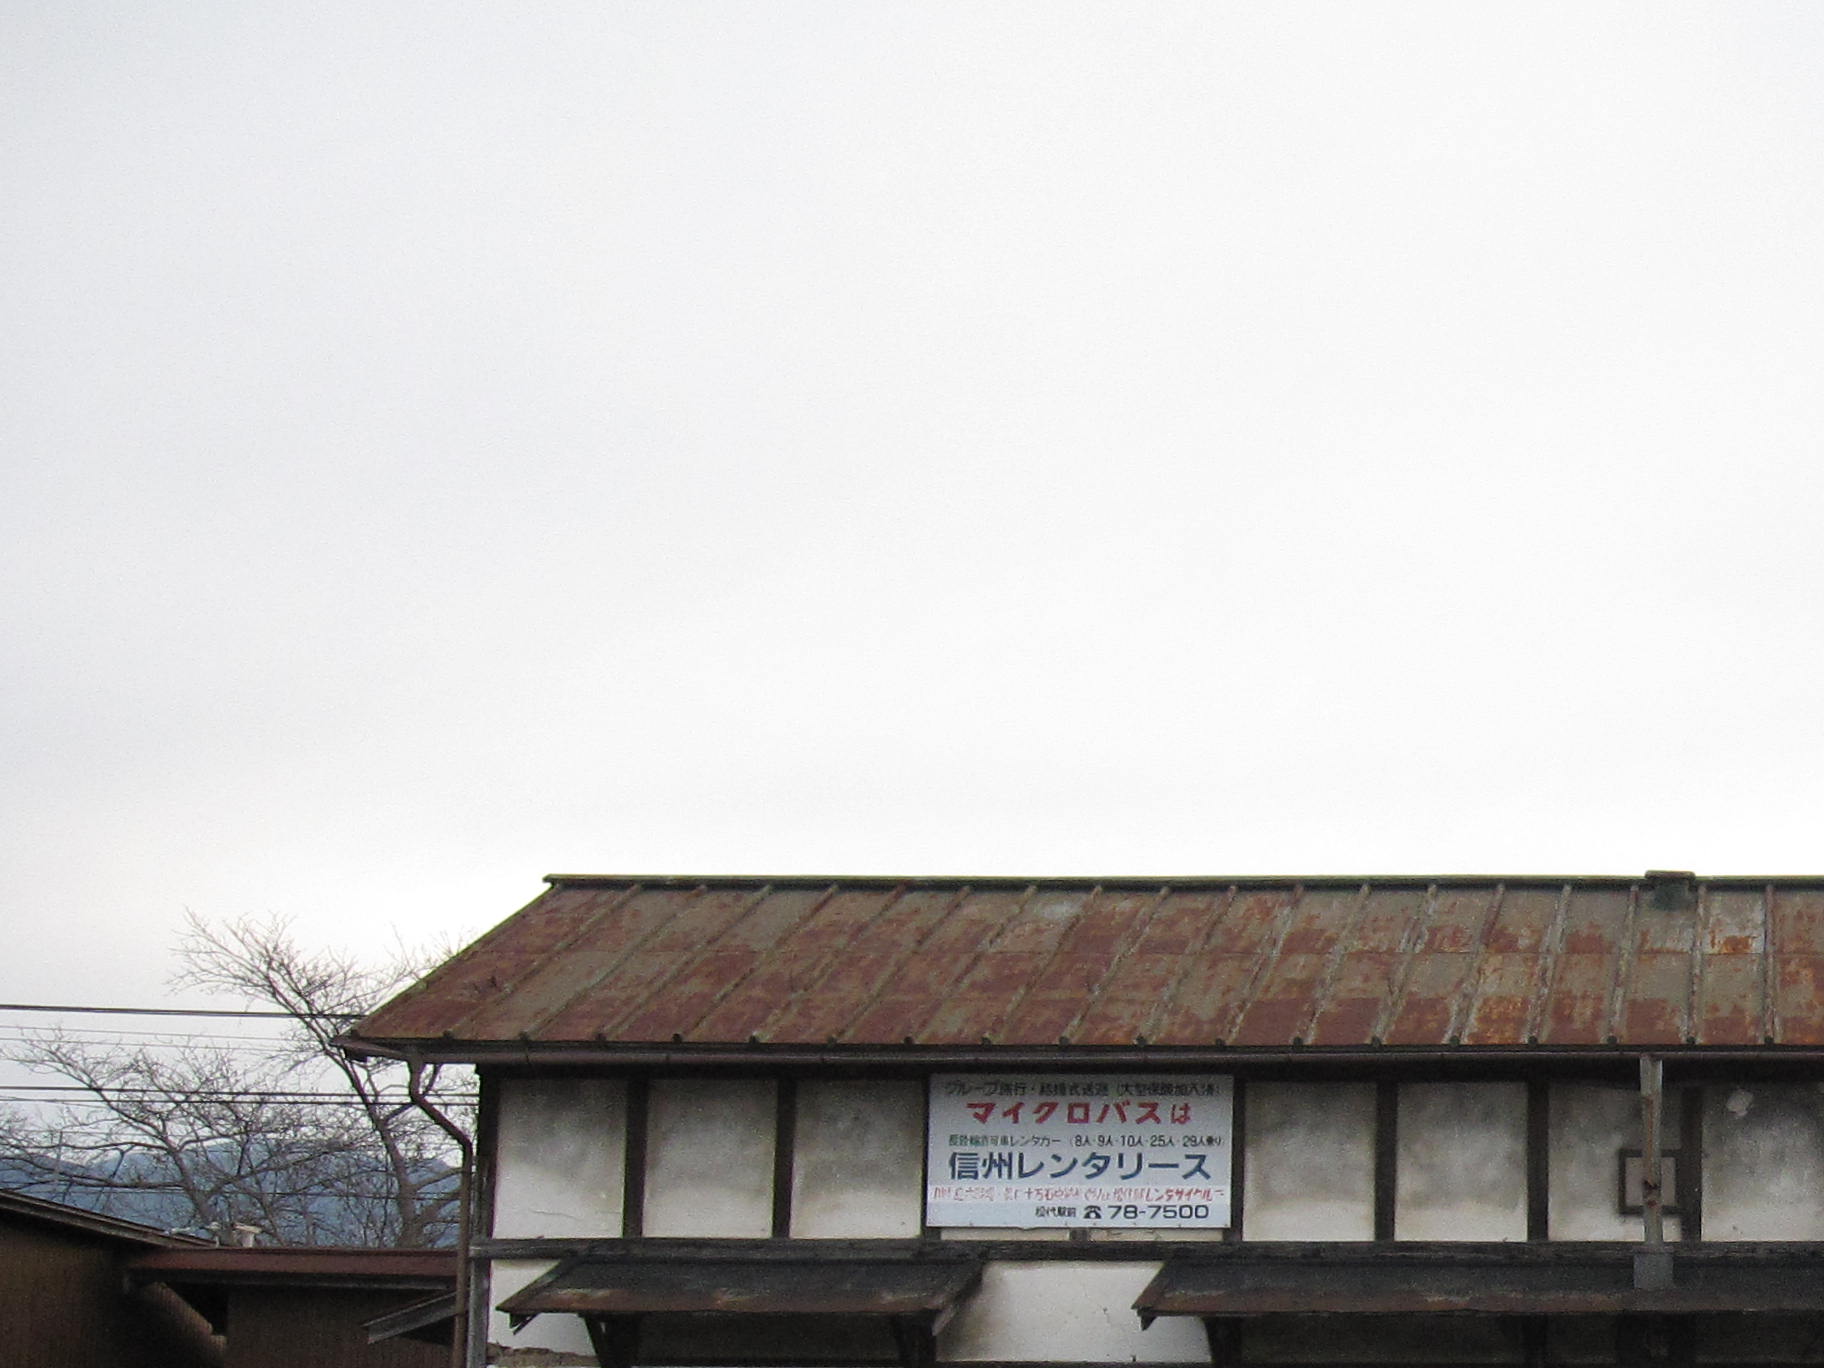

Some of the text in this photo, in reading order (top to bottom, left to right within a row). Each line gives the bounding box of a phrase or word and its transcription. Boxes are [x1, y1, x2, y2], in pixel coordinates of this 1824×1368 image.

[966, 1100, 1192, 1124] マイクロバスは
[949, 1151, 1211, 1180] 信州レンタリース
[1107, 1204, 1209, 1220] 78-7500
